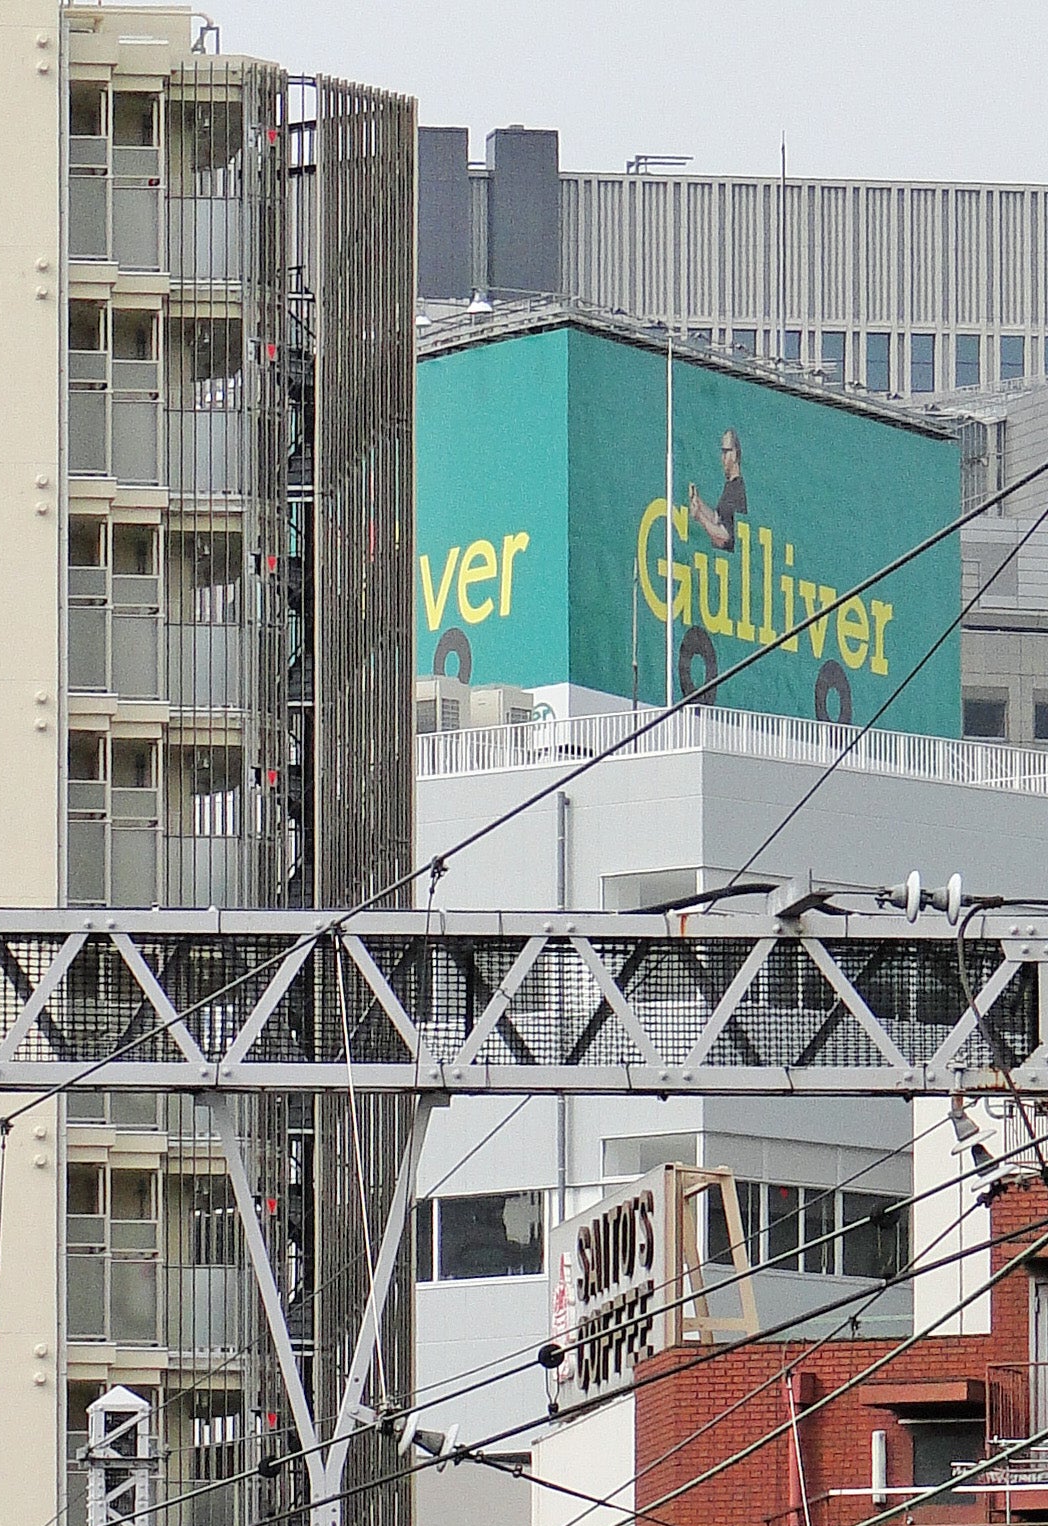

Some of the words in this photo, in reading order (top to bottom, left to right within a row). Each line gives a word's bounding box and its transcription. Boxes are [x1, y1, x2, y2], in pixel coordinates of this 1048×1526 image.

[637, 498, 893, 675] Gulliver
[576, 1190, 654, 1306] SAITO'S
[576, 1280, 654, 1394] COFFEE
